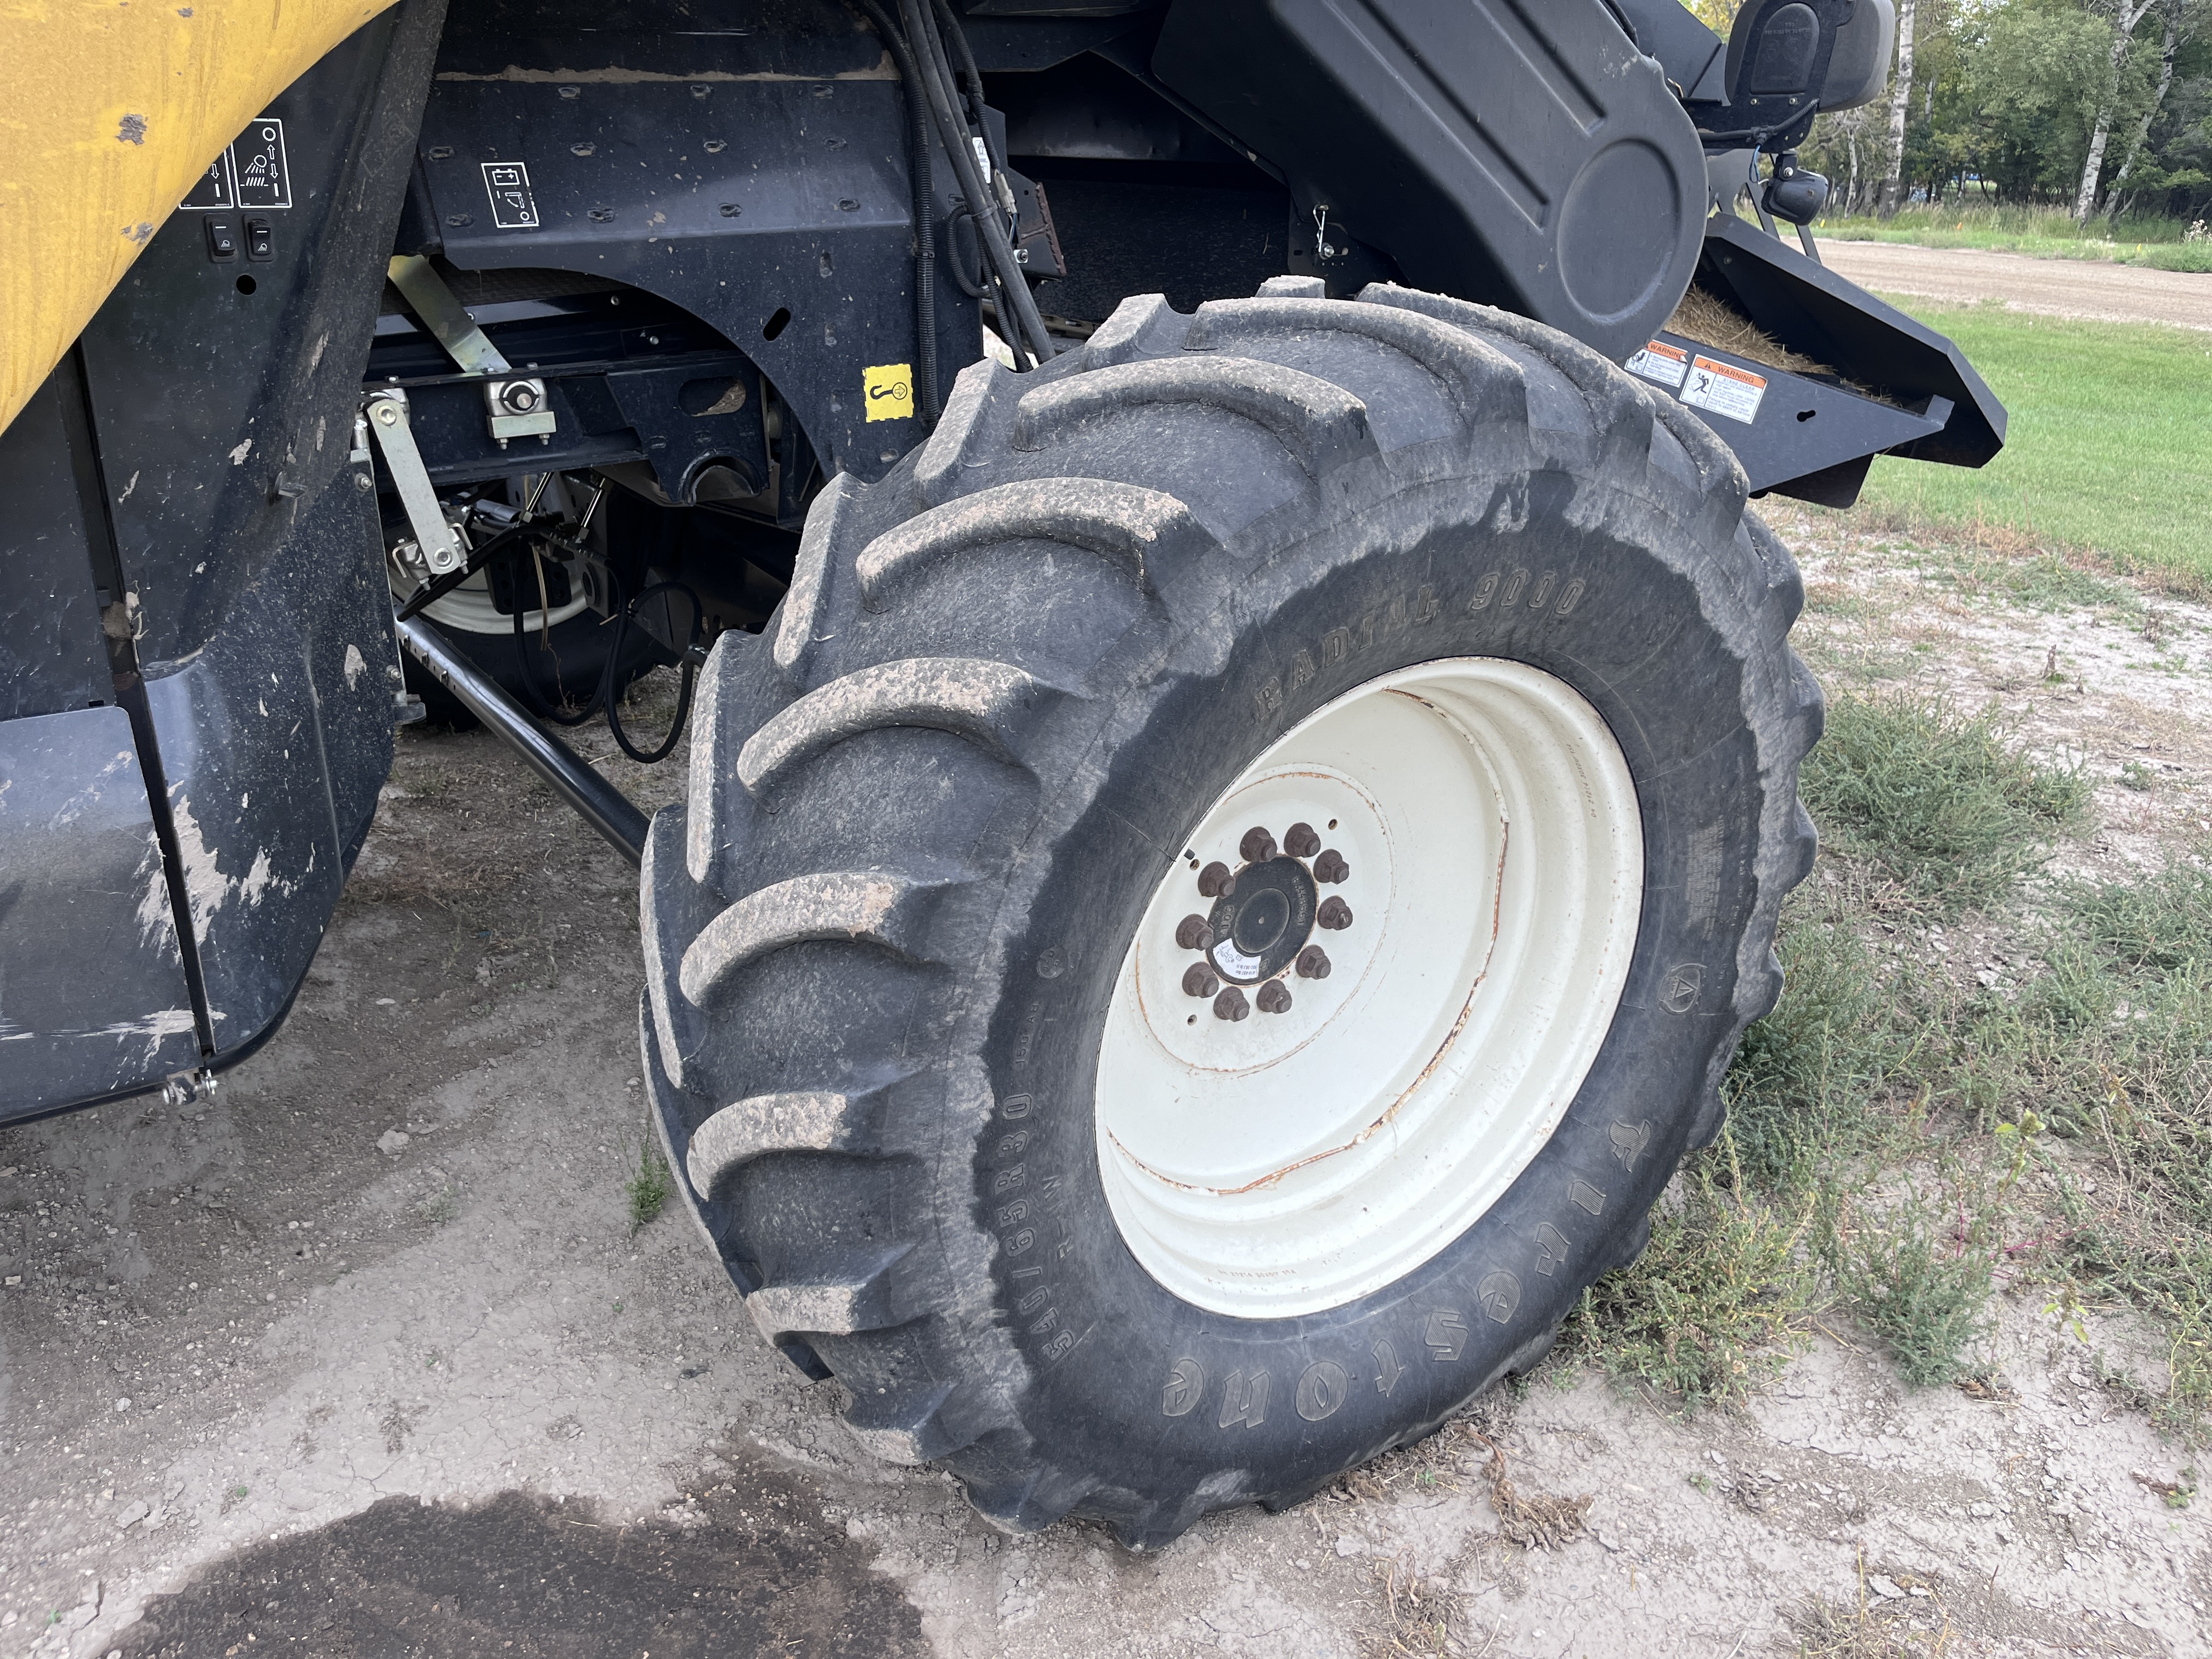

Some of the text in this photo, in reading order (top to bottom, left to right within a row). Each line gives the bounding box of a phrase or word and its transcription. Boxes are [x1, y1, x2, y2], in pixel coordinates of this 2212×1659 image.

[1718, 366, 1754, 383] WARNING
[1253, 568, 1586, 721] RADIAL 9000
[994, 1092, 1076, 1363] 540/65R30
[1160, 1118, 1652, 1429] Firestone
